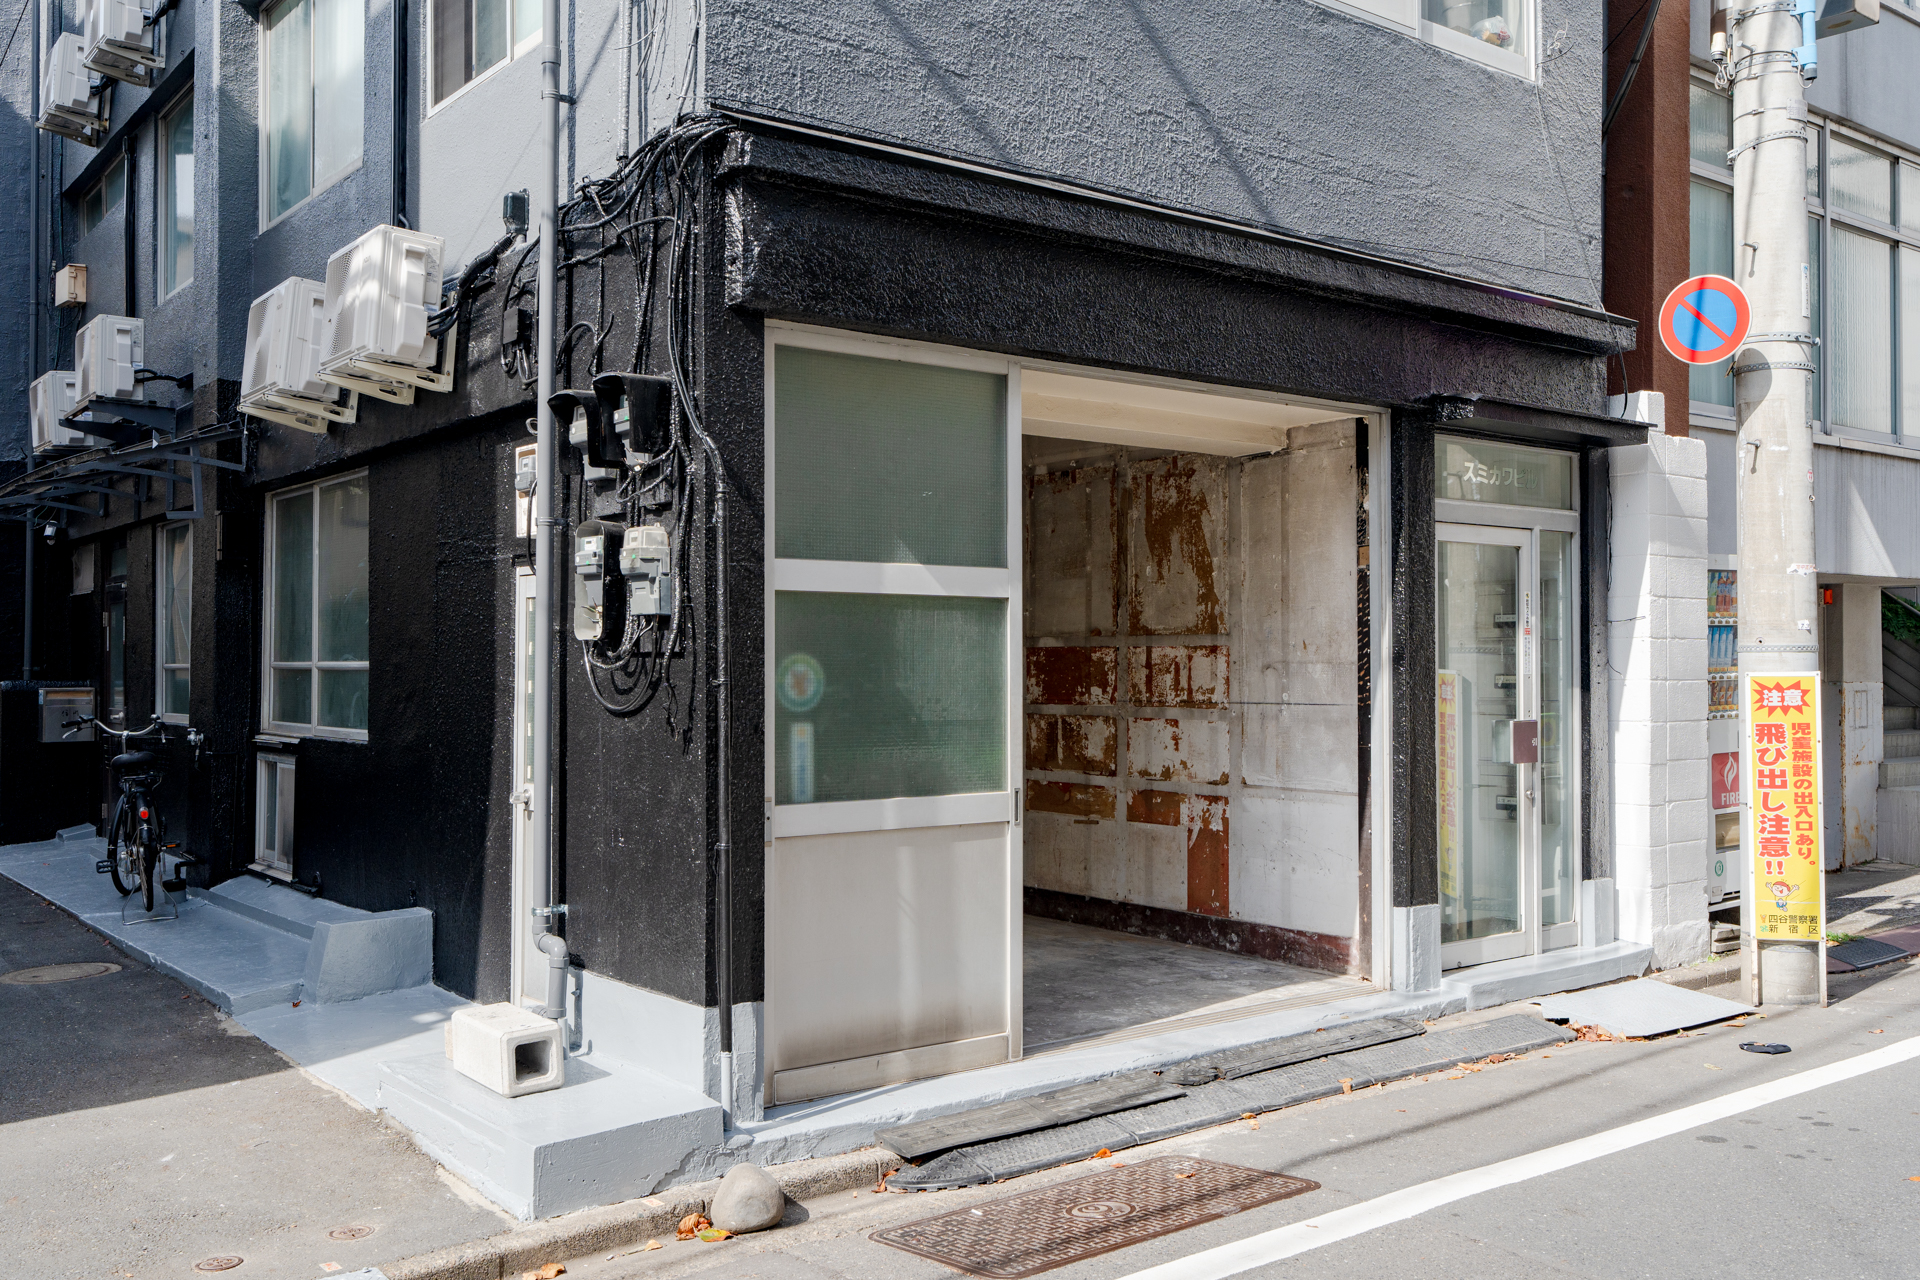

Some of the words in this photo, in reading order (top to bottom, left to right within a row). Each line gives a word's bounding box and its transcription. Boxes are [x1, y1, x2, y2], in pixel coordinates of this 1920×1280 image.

[1463, 461, 1538, 489] スミカワビル
[1762, 689, 1803, 706] 注意
[1531, 737, 1538, 747] 引
[1791, 722, 1816, 865] 児童施設の出入口あり。
[1768, 914, 1818, 925] 四谷警察署
[1768, 924, 1818, 934] 新宿区
